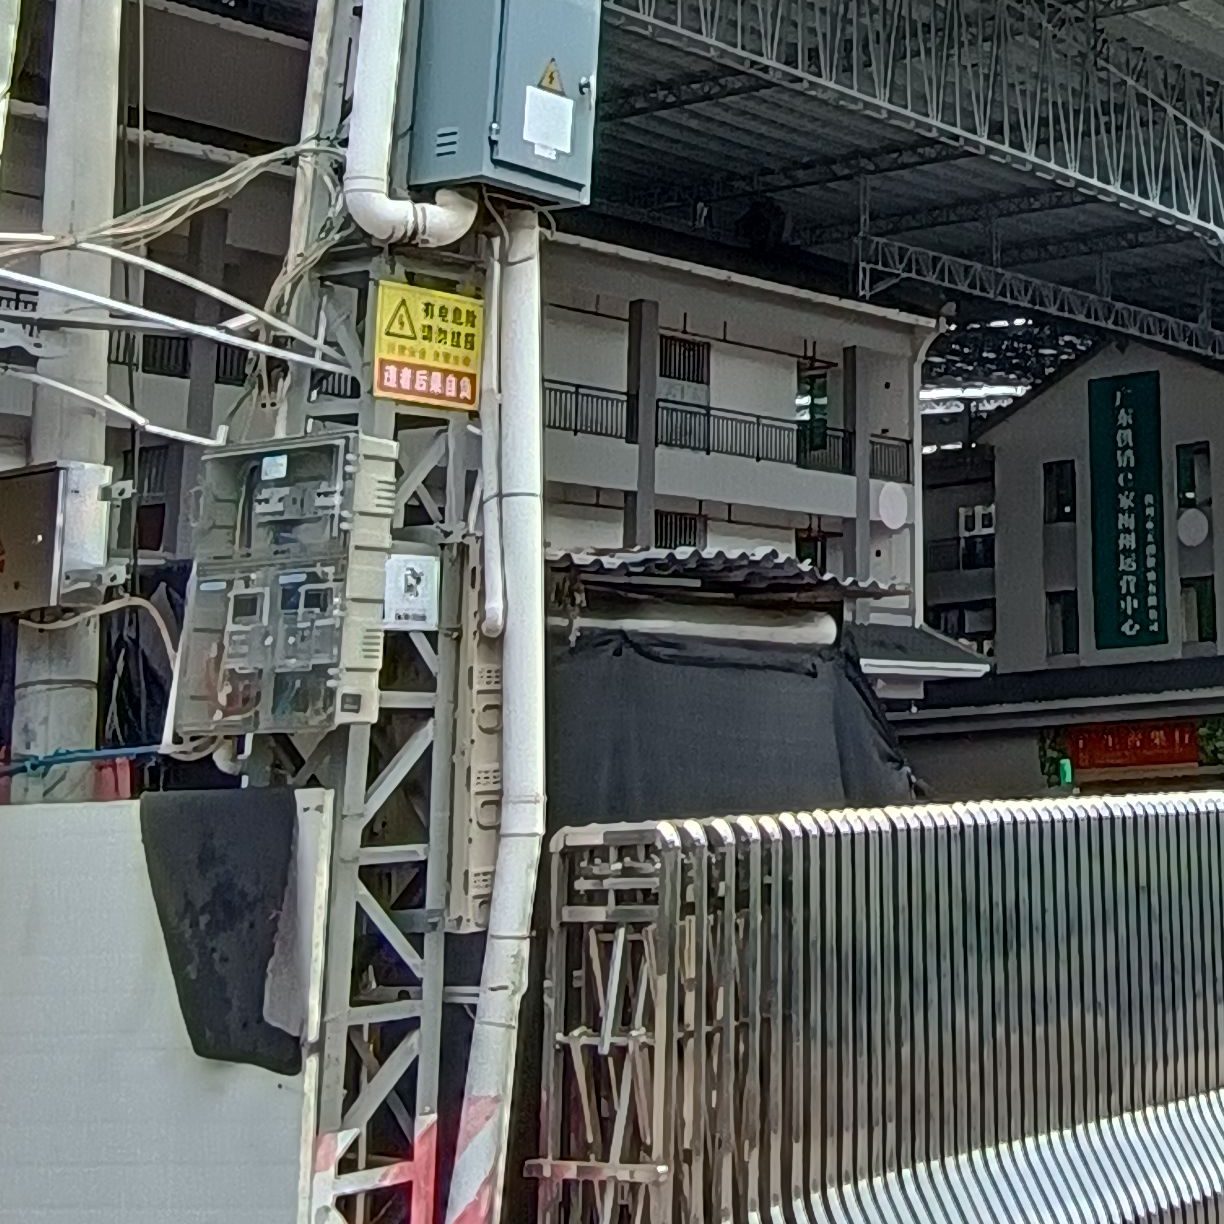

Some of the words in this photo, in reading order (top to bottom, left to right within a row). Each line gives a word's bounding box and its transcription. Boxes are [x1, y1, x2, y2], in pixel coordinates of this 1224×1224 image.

[383, 364, 472, 400] 违者后果自负
